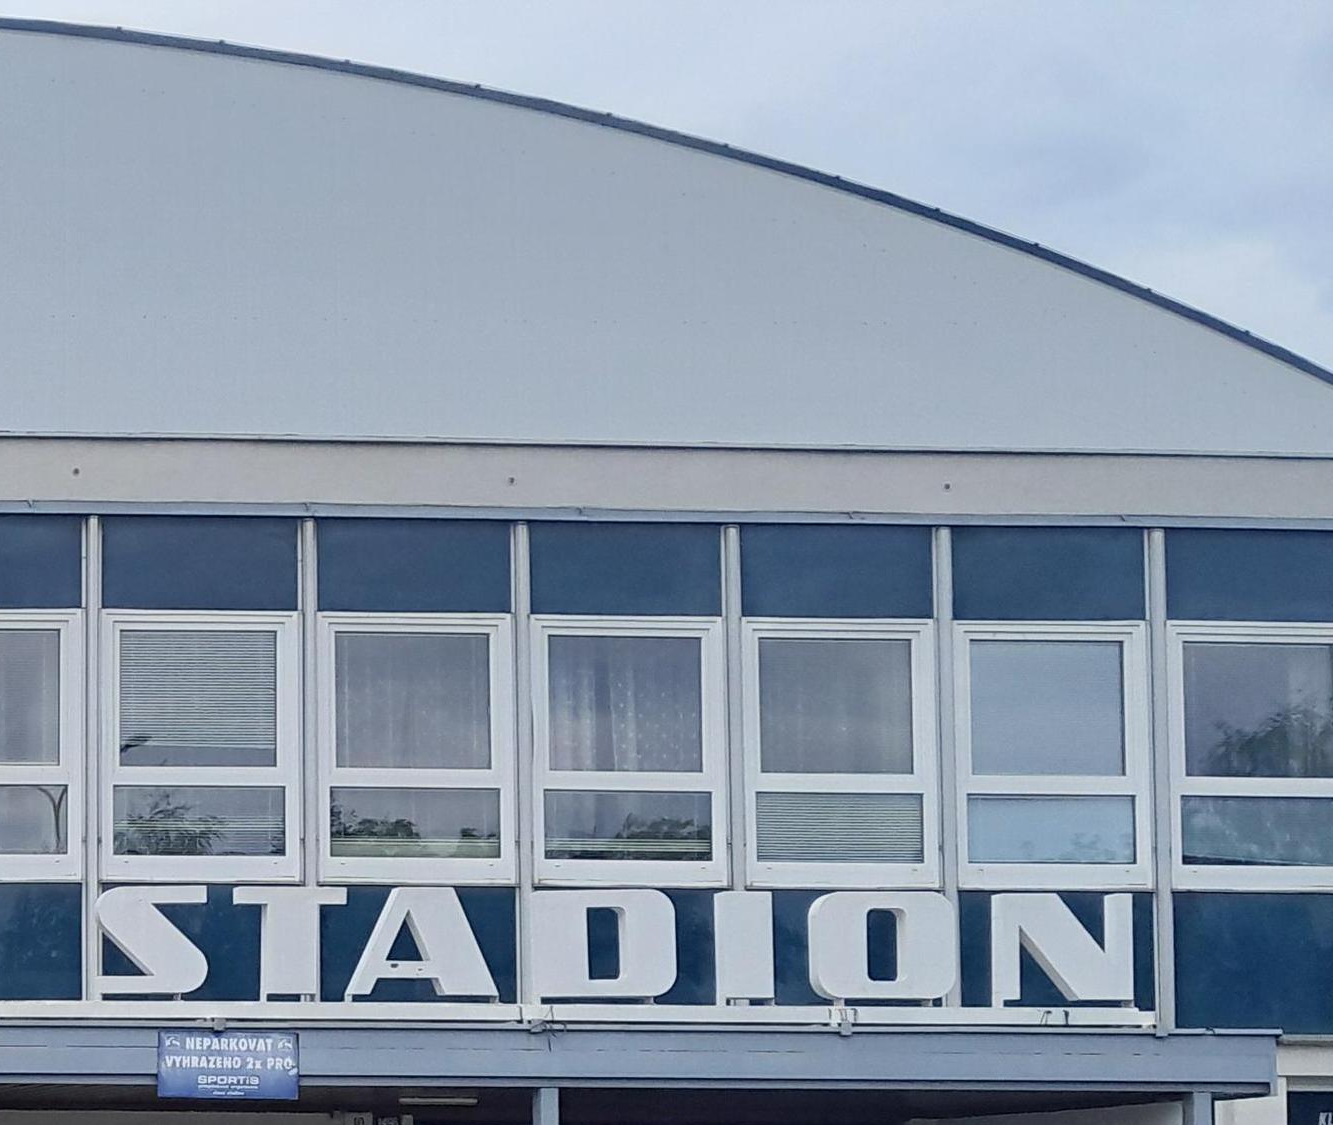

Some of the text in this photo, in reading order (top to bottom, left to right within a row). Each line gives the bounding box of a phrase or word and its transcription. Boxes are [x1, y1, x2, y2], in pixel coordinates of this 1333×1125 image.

[95, 885, 1135, 1001] STADION
[186, 1037, 273, 1052] NEPARKOVAT
[164, 1056, 241, 1069] VYHRAZENO
[246, 1057, 262, 1070] 2x
